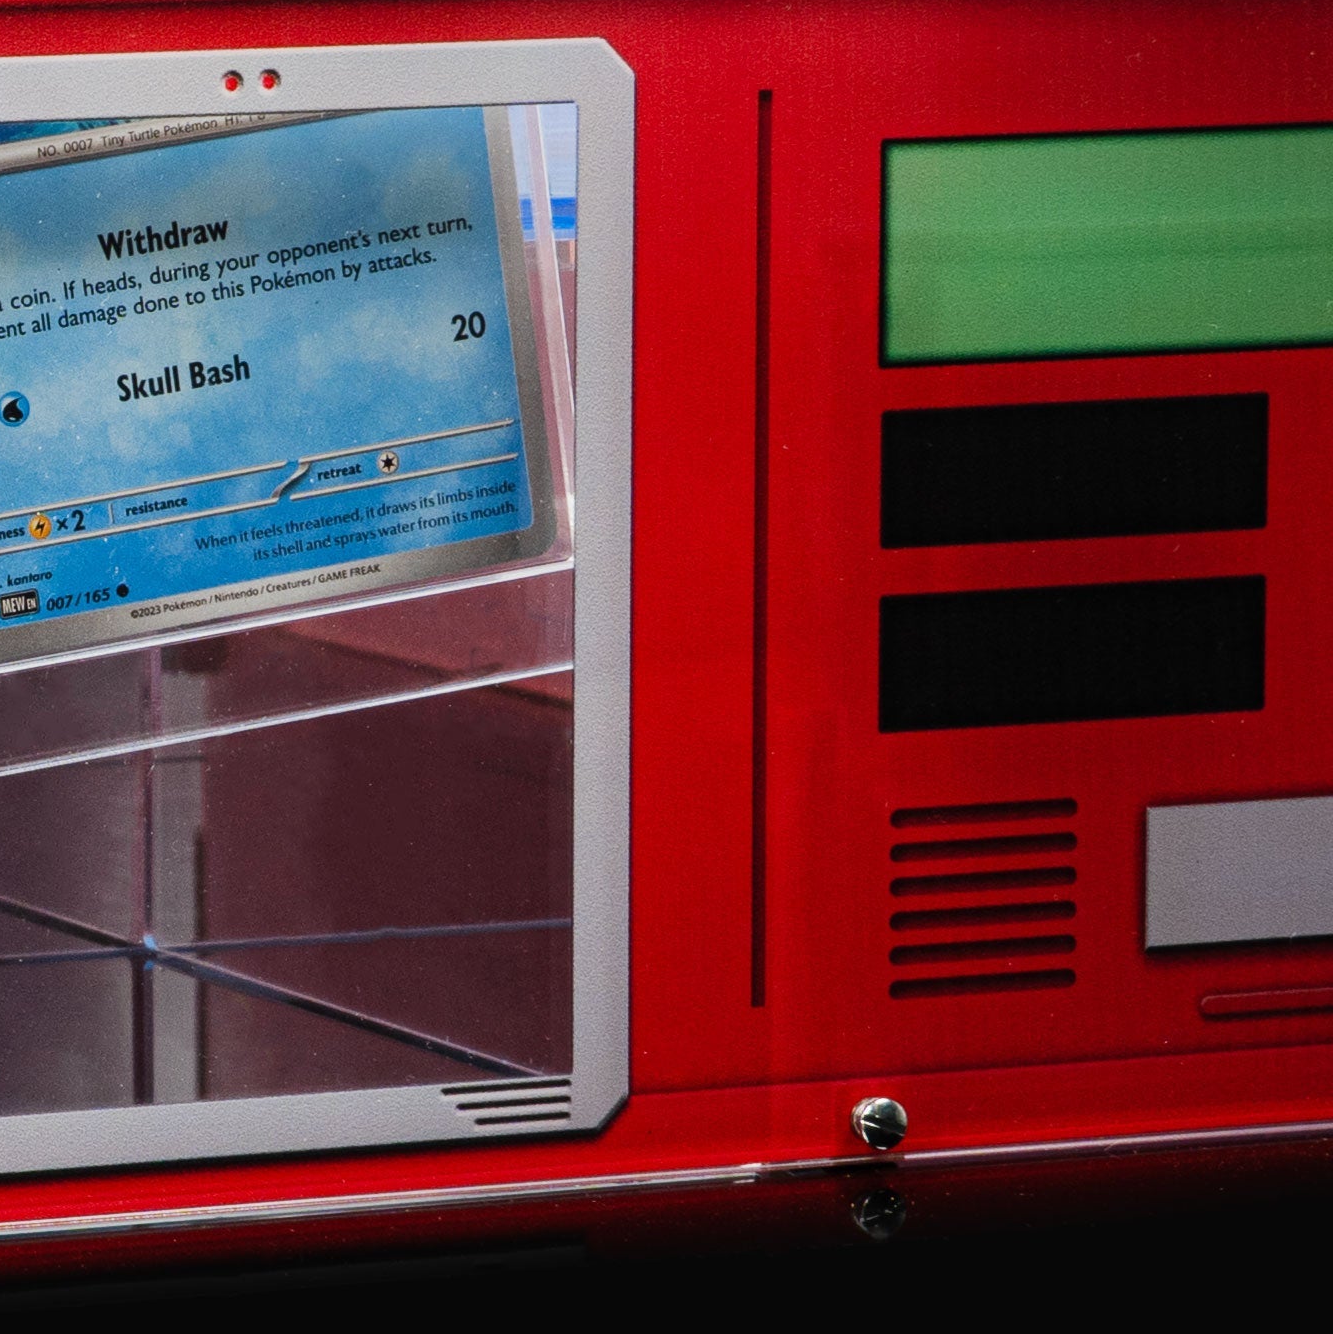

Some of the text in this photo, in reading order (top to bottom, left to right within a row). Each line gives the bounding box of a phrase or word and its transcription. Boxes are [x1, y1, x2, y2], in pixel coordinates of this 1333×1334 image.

[37, 146, 60, 159] NO.
[63, 138, 93, 155] 0007
[101, 133, 124, 151] Tiny
[128, 126, 160, 146] Turtle
[164, 118, 218, 139] Pokémon
[11, 288, 56, 310] coin.
[64, 281, 76, 301] If
[83, 273, 142, 299] heads,
[149, 262, 210, 289] during
[216, 254, 260, 280] your
[267, 231, 371, 271] opponent's
[378, 224, 421, 246] next
[427, 216, 472, 236] turn,
[97, 221, 228, 262] Withdraw
[31, 315, 51, 333] all
[58, 301, 126, 331] damage
[133, 293, 179, 315] done
[186, 288, 205, 307] to
[211, 279, 245, 301] this
[250, 266, 335, 295] Pokémon
[341, 262, 361, 283] by
[368, 246, 437, 274] attacks.
[116, 311, 486, 402] Skull Bash 20
[125, 497, 187, 517] resistance
[317, 464, 362, 482] retreat
[196, 480, 516, 551] When it feels threatened, it draws its limbs inside
[7, 570, 52, 587] kantaro
[214, 587, 259, 603] Nintendo
[267, 578, 312, 594] Creatures
[318, 570, 348, 583] GAME
[350, 564, 380, 578] FREAK
